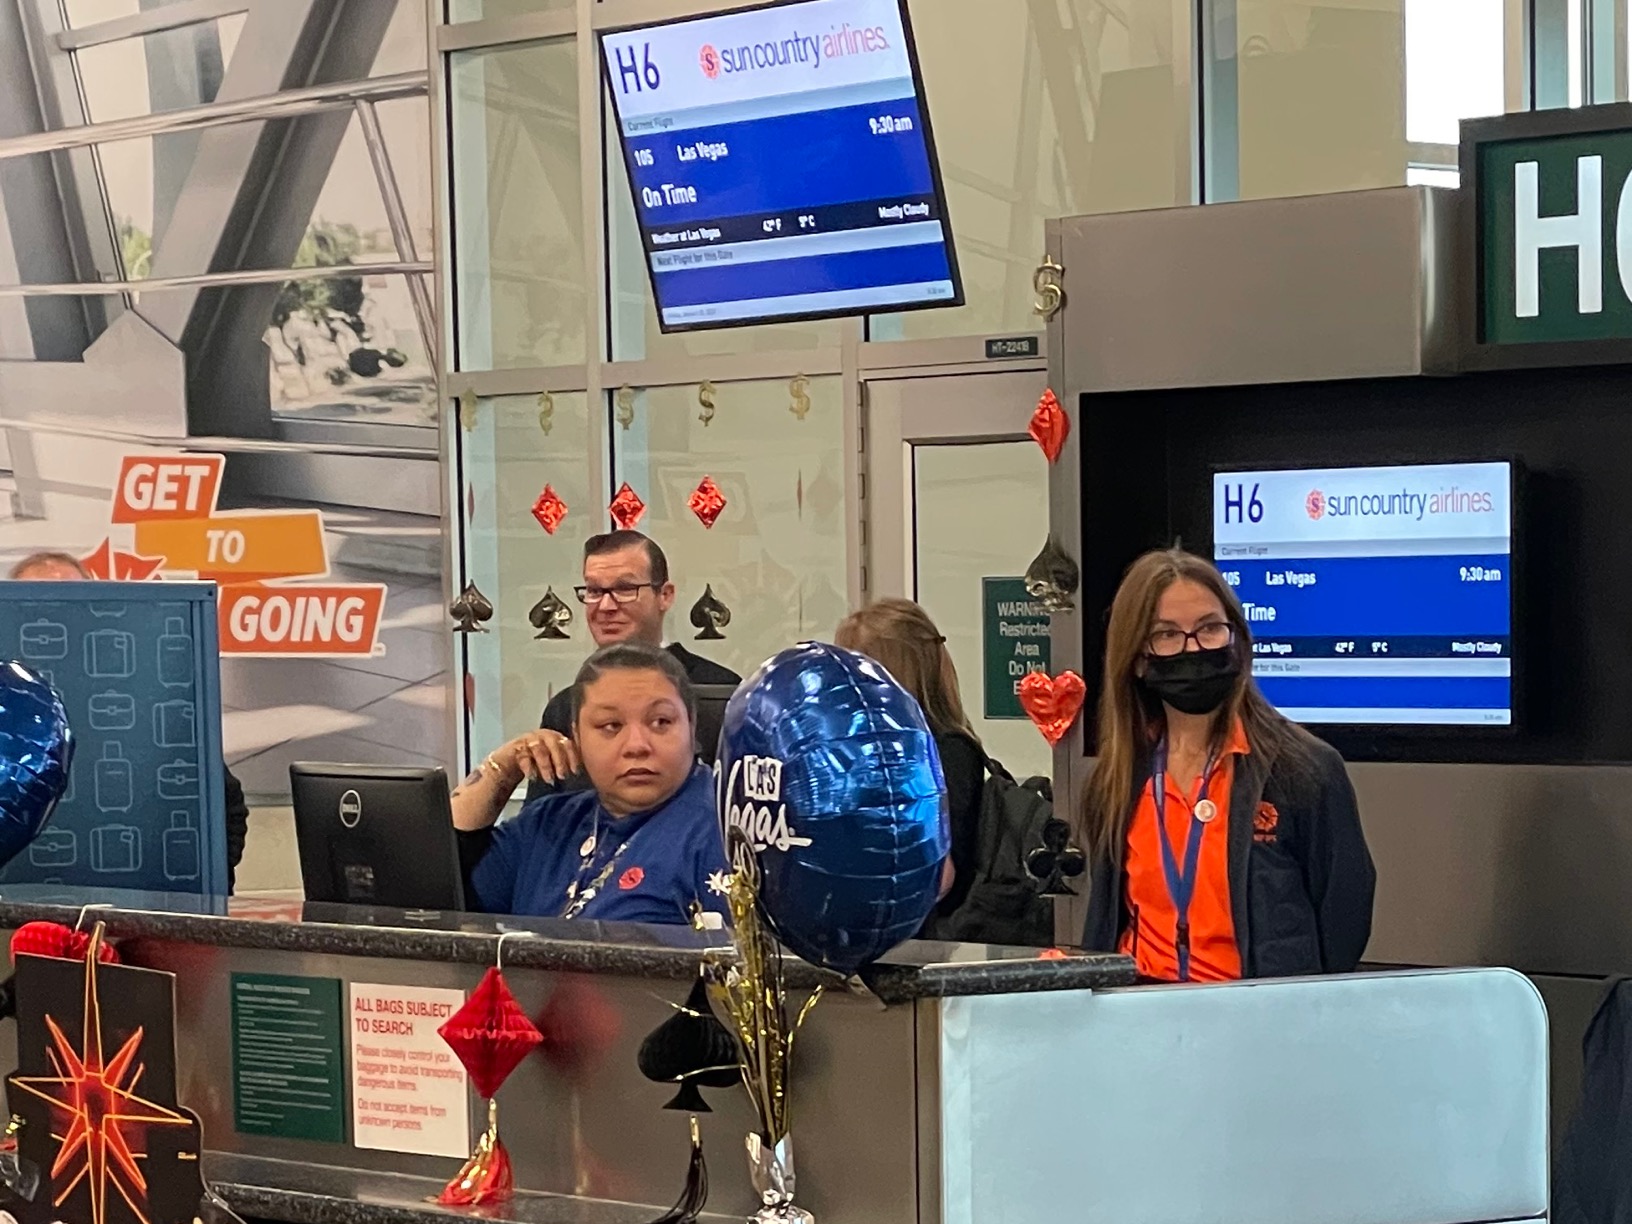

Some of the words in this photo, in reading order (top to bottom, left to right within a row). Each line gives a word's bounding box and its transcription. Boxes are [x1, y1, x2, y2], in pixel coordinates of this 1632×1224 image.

[614, 42, 660, 94] H6
[634, 148, 655, 167] 105
[676, 144, 697, 162] Las
[696, 141, 729, 162] Vegas
[642, 186, 662, 208] On
[661, 183, 697, 206] Time
[123, 464, 209, 511] GET
[1224, 482, 1265, 525] H6
[206, 530, 246, 563] TO
[1265, 571, 1285, 585] Las
[1285, 570, 1317, 588] Vegas
[229, 596, 366, 644] GOING
[997, 601, 1050, 617] WARN
[1241, 602, 1277, 621] Time
[1014, 641, 1040, 656] Area
[1008, 660, 1024, 676] Do
[355, 997, 373, 1012] ALL
[376, 999, 404, 1015] BAGS
[406, 1001, 453, 1018] SUBJECT
[355, 1018, 370, 1033] TO
[372, 1019, 414, 1036] SEARCH
